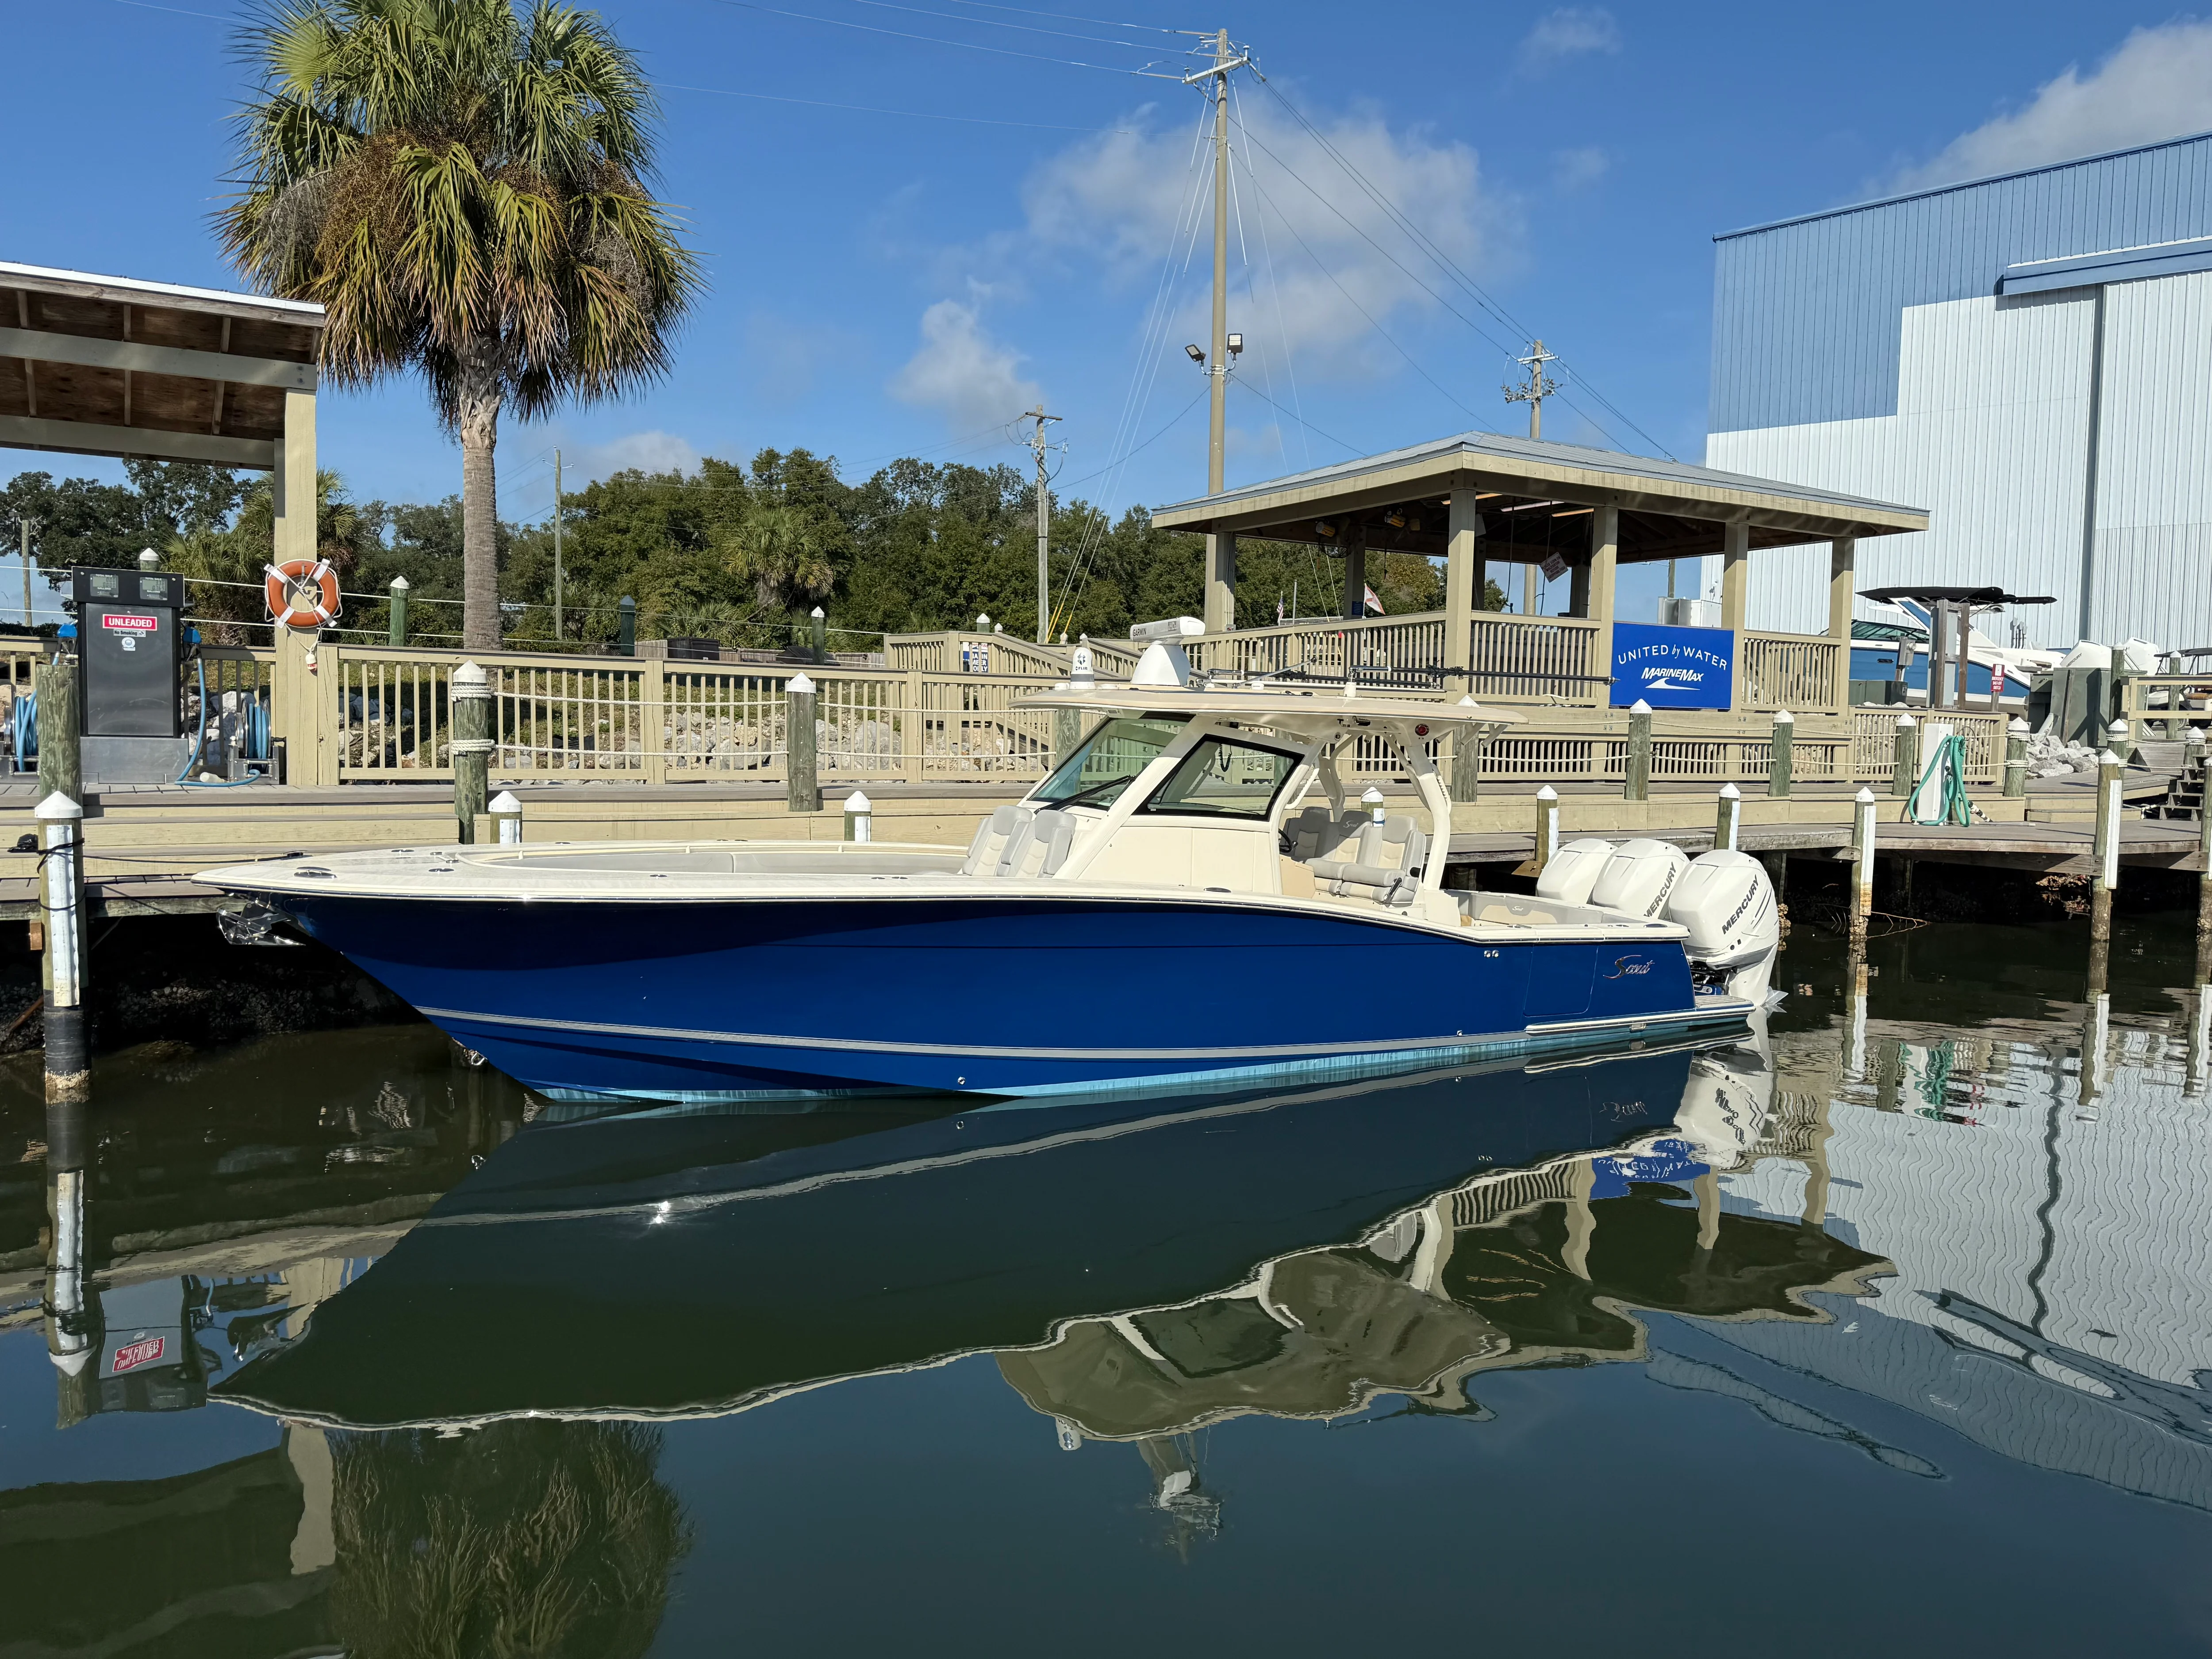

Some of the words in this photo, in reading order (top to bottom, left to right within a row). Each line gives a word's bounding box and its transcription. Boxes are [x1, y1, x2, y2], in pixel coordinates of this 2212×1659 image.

[108, 618, 152, 627] UNLEADED
[1133, 628, 1146, 636] GARMIN
[1618, 645, 1669, 664] UNITED
[1672, 644, 1680, 659] by
[1683, 646, 1727, 670] WATER
[1721, 874, 1759, 935] MERCURY
[1603, 955, 1655, 979] Scout
